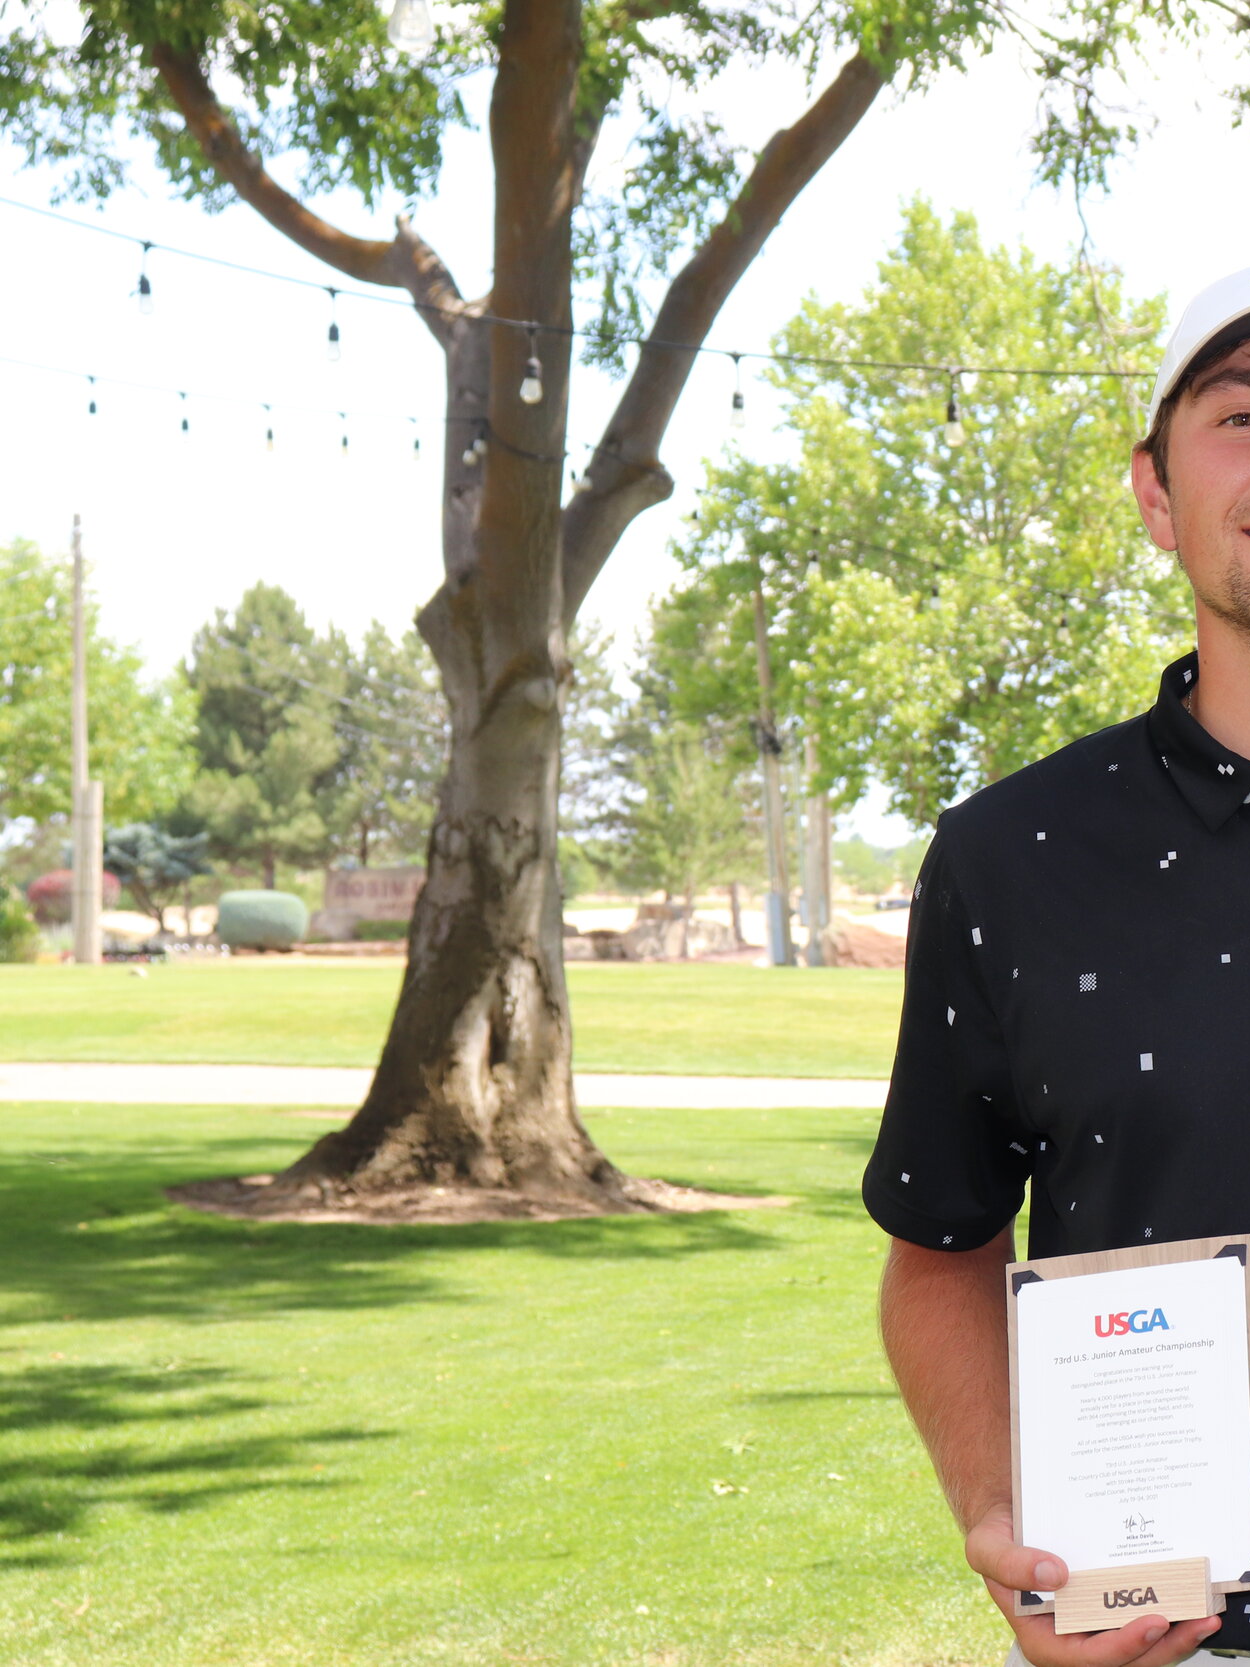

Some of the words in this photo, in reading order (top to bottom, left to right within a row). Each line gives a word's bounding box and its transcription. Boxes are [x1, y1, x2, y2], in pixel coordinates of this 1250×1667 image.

[1094, 1308, 1170, 1338] USGA
[1054, 1356, 1072, 1365] 73rd
[1074, 1354, 1089, 1362] U.S.
[1091, 1350, 1117, 1360] Junior
[1118, 1346, 1154, 1357] Amateur
[1156, 1338, 1215, 1354] Championship
[1094, 1368, 1134, 1378] Congratulations
[1071, 1381, 1103, 1390] distinguished
[1080, 1405, 1101, 1413] annually
[1099, 1411, 1127, 1419] comprising
[1138, 1407, 1157, 1415] starting
[1107, 1419, 1130, 1427] emerging
[1071, 1449, 1093, 1457] compete
[1164, 1463, 1189, 1471] Dogwood
[1103, 1586, 1159, 1609] USGA
